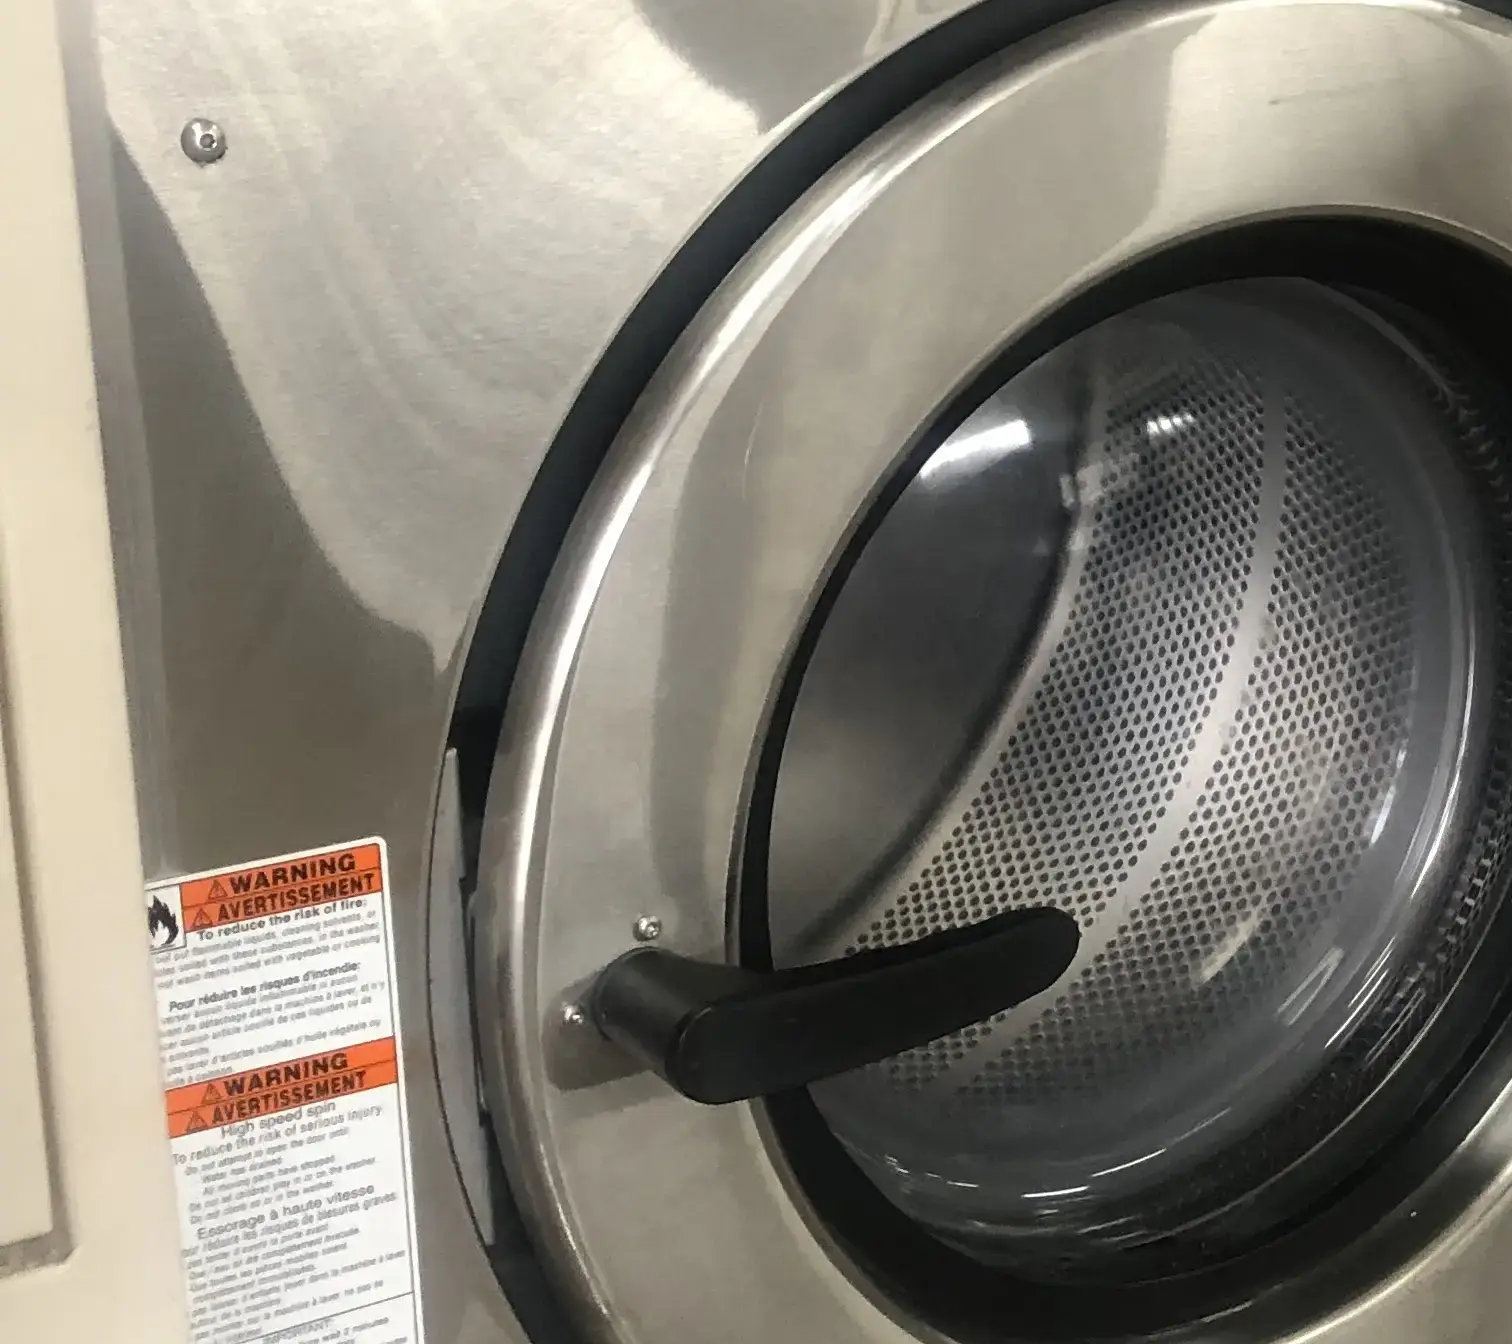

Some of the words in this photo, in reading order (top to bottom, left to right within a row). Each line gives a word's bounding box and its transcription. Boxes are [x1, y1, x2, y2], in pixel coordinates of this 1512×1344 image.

[230, 853, 356, 895] WARNING
[218, 873, 375, 922] AVERTISSEMENT
[198, 929, 214, 942] To
[218, 919, 266, 937] reduce
[269, 913, 291, 926] the
[294, 907, 320, 921] risk
[324, 901, 338, 914] of
[169, 998, 196, 1013] Pour
[240, 985, 257, 996] les
[259, 975, 300, 992] risques
[224, 1053, 349, 1097] WARNING
[212, 1070, 366, 1124] AVERTISSEMENT
[220, 1119, 255, 1139] High
[259, 1109, 303, 1130] speed
[307, 1100, 336, 1120] spin
[197, 1214, 265, 1240] Essorage
[282, 1199, 323, 1216] haute
[326, 1184, 375, 1205] vitesse
